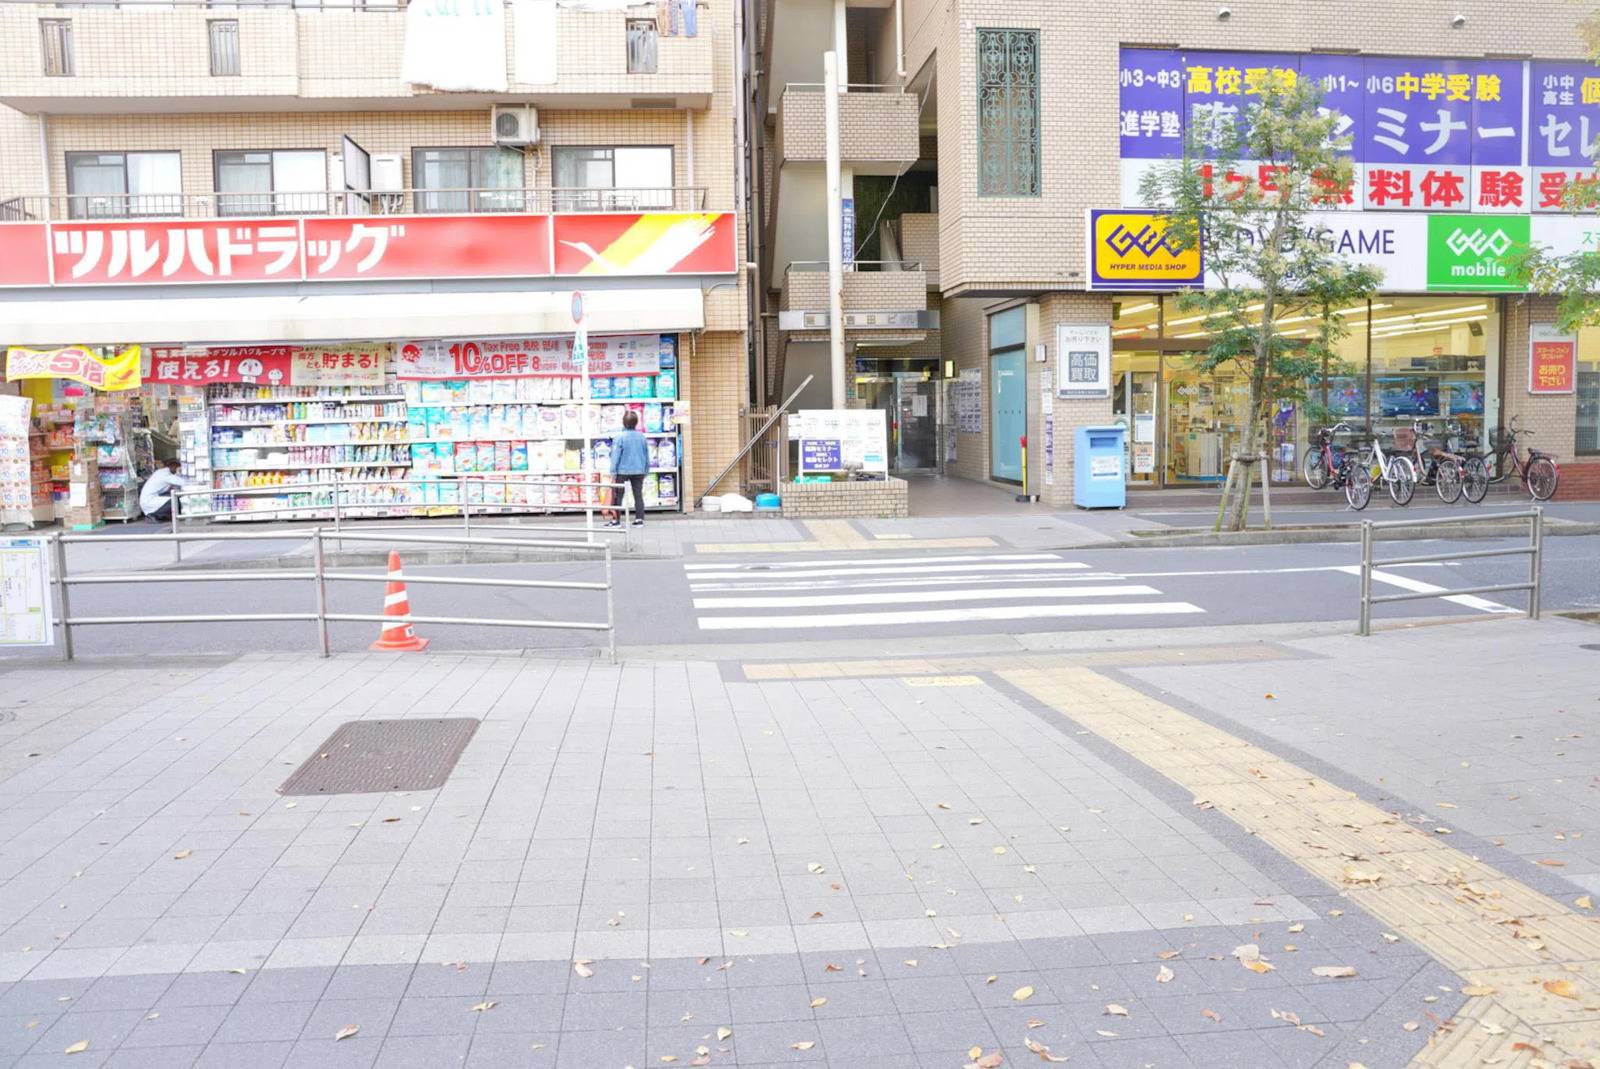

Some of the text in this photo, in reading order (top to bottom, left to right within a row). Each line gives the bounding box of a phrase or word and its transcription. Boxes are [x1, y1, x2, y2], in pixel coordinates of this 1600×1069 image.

[1395, 72, 1502, 101] 中学受験
[1120, 110, 1181, 138] 進学塾
[54, 223, 405, 279] ツルハドラッグ
[1446, 228, 1513, 256] GEO
[1451, 257, 1506, 277] mobile
